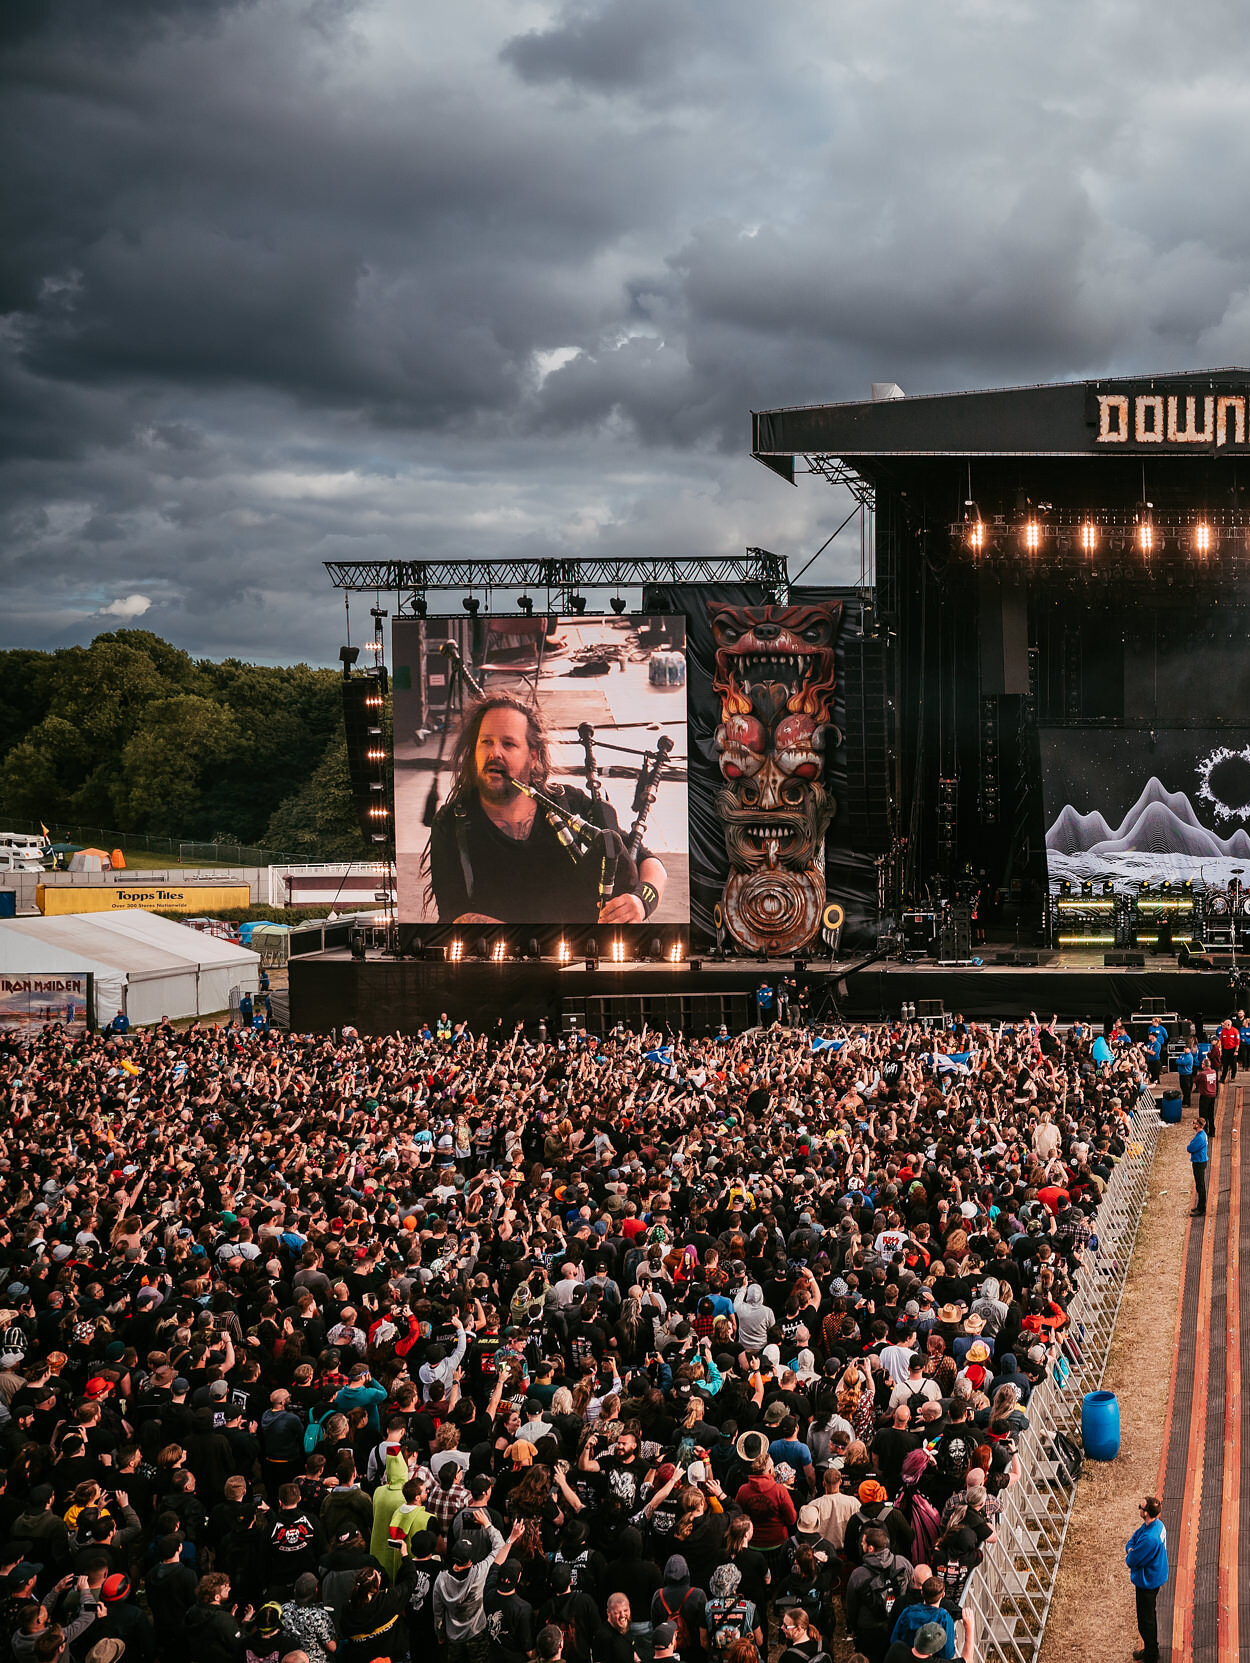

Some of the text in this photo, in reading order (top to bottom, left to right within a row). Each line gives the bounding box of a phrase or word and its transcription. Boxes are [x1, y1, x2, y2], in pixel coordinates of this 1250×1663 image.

[116, 890, 184, 901] Topps Tiles
[1, 980, 81, 994] IRON MAIDEN
[882, 1236, 900, 1246] KISS
